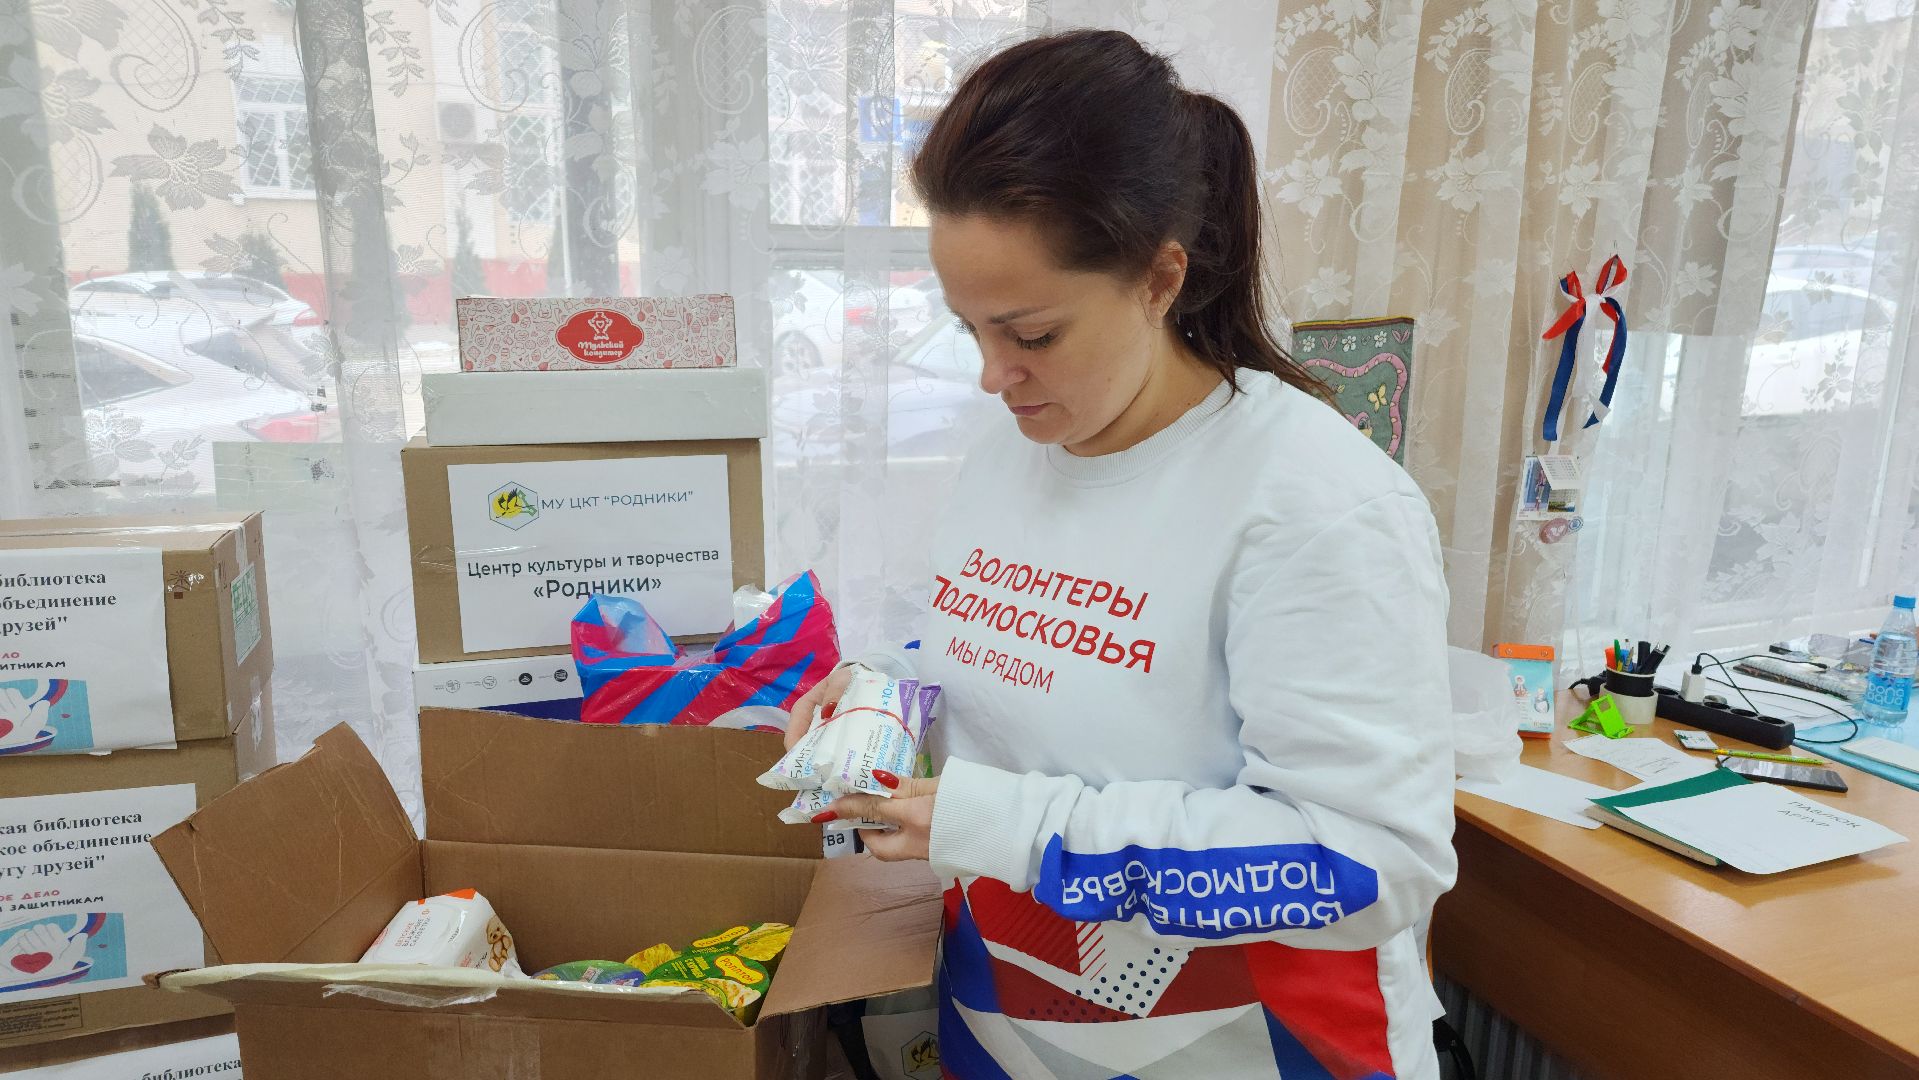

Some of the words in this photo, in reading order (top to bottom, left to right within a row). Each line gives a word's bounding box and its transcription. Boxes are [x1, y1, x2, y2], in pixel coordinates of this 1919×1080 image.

[541, 498, 565, 510] МУ
[570, 496, 600, 510] ЦКТ
[467, 562, 522, 579] Центр
[527, 556, 606, 576] культуры
[612, 556, 622, 567] и
[627, 550, 719, 568] творчества
[0, 573, 107, 588] иблиотека
[533, 577, 662, 600] «Родники»
[959, 548, 1149, 621] ВОЛОНТЕРЫ
[0, 595, 117, 610] бъединение
[0, 616, 68, 637] рузей"
[945, 636, 982, 667] МЫ
[982, 649, 1055, 694] РЯДОМ
[33, 813, 143, 833] библиотека
[33, 833, 152, 854] объединение
[10, 896, 104, 912] ЗАЩИТНИКАМ
[21, 889, 60, 900] ДЕЛО
